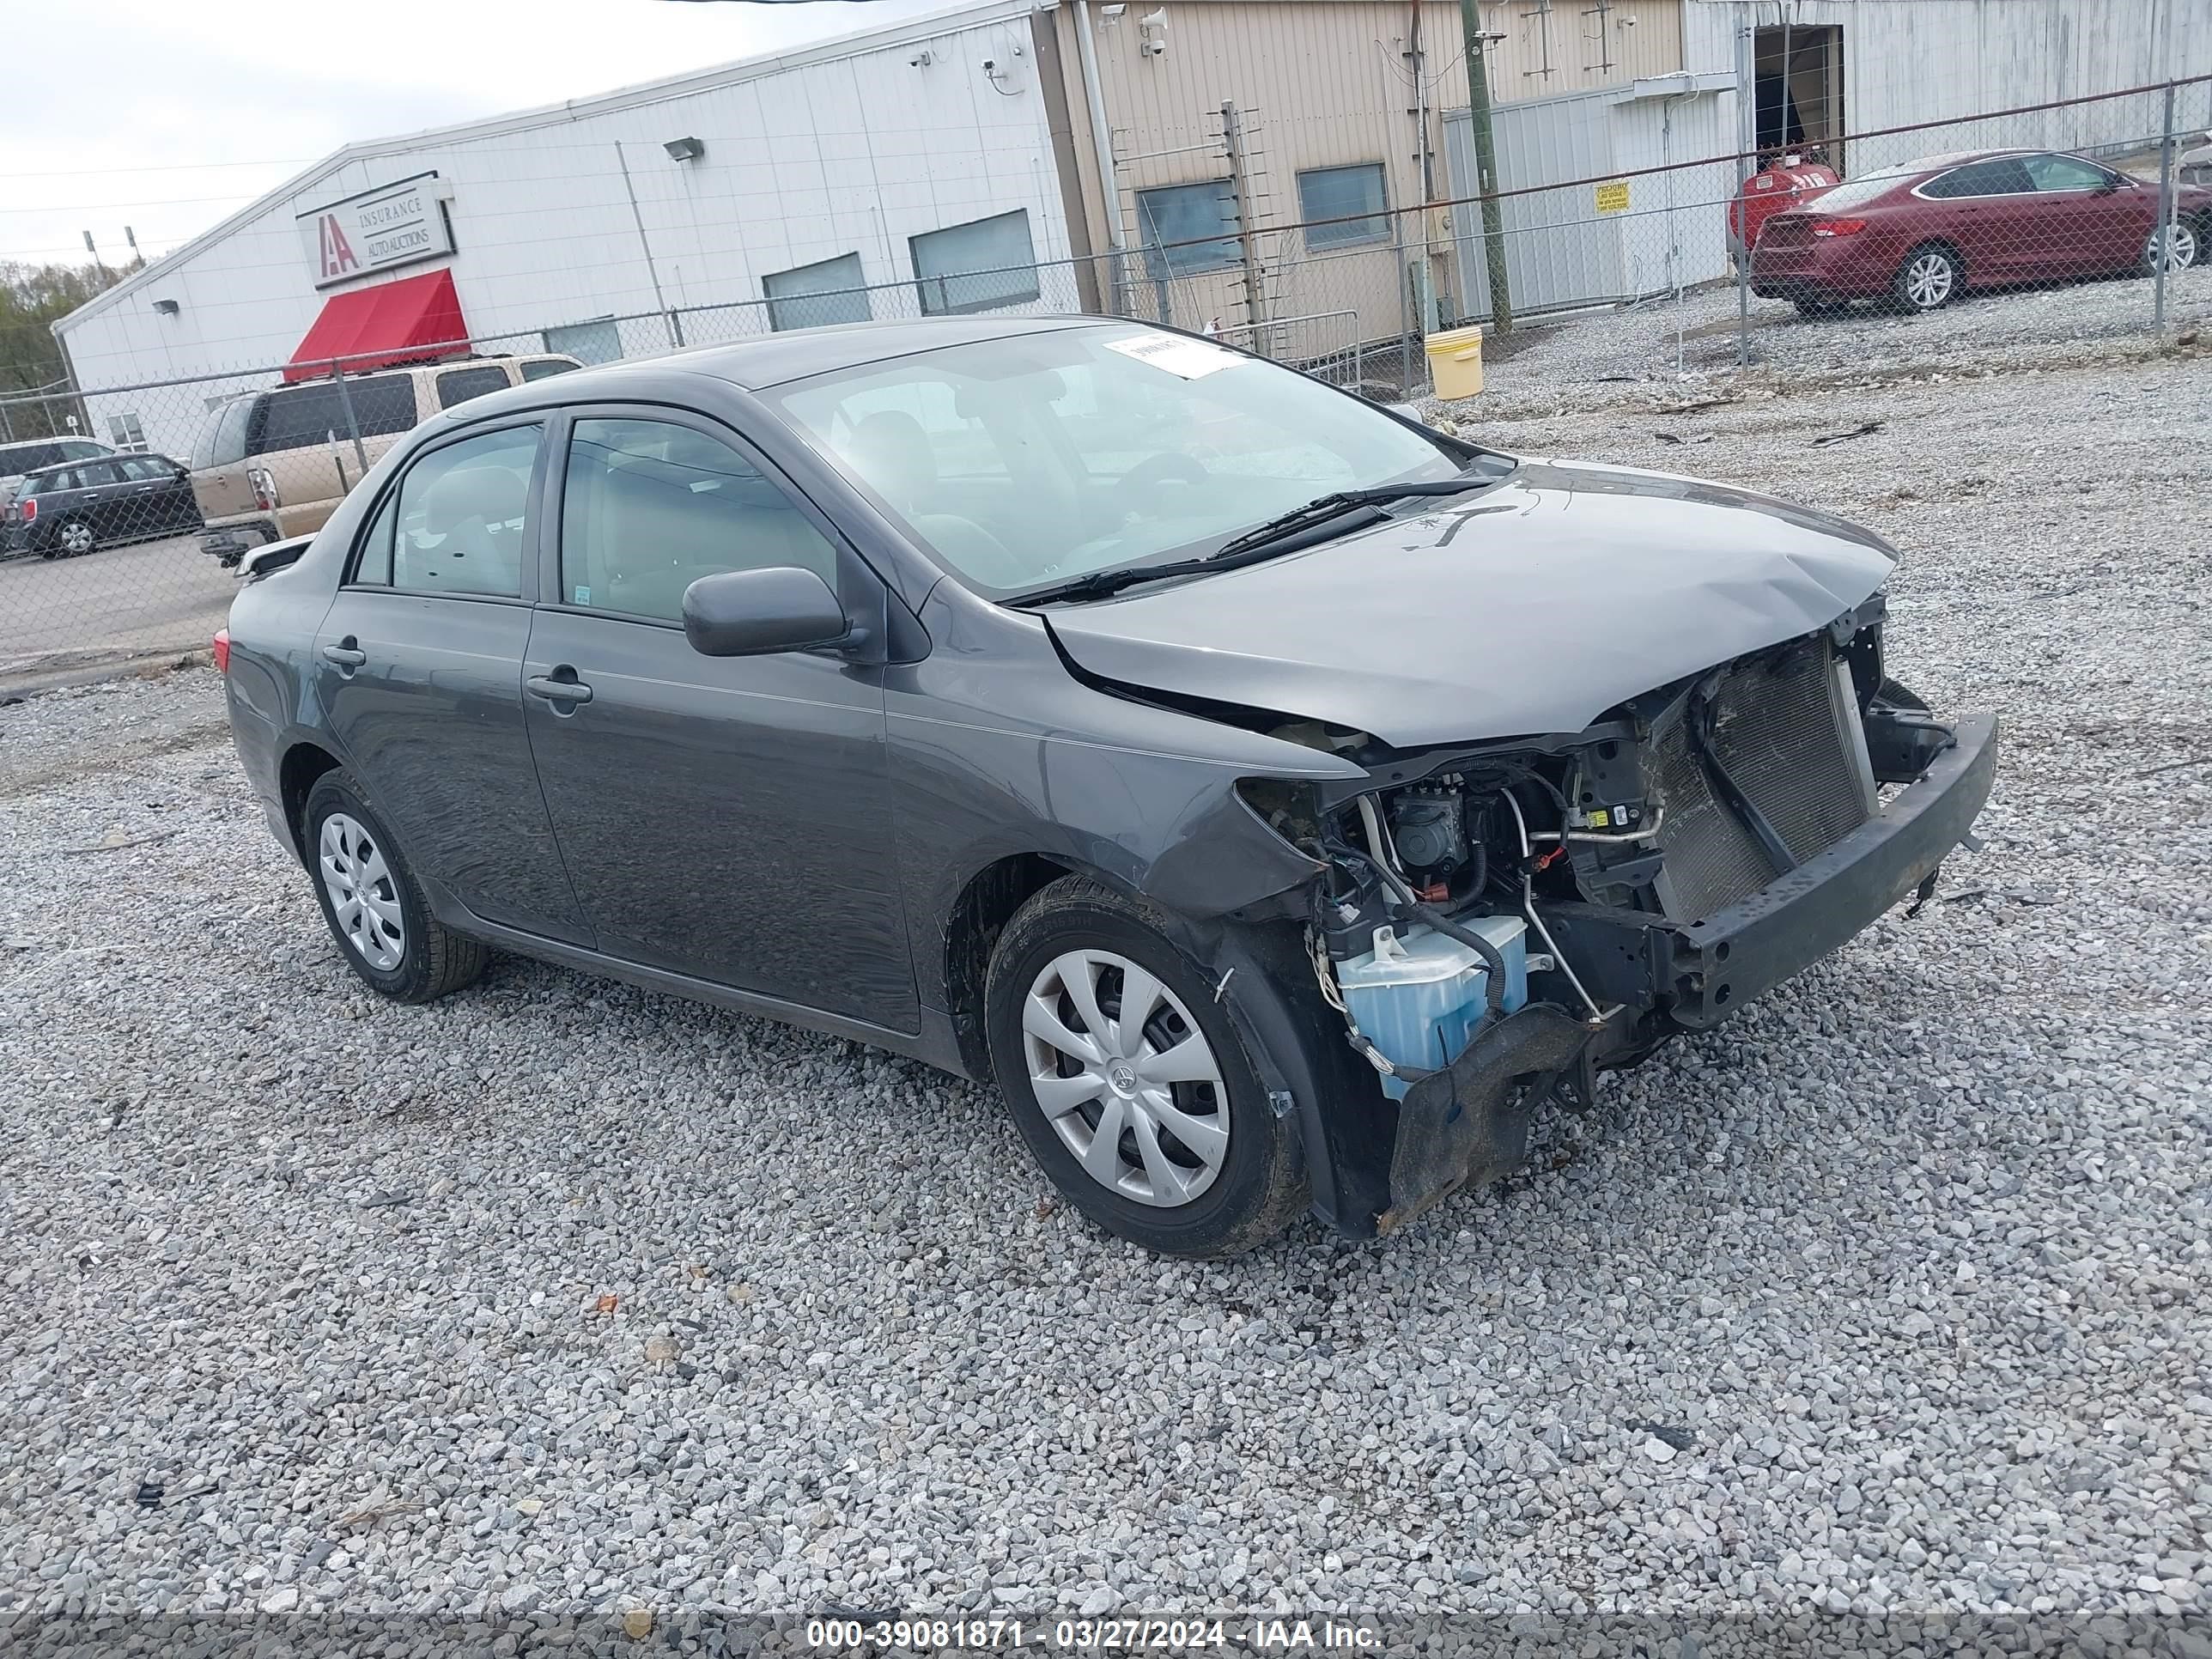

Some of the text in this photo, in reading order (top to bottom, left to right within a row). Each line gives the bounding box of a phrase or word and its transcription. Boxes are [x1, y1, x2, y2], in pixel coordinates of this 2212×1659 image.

[359, 198, 422, 228] INSURANCE
[368, 228, 429, 258] AUTO AUCTIONS
